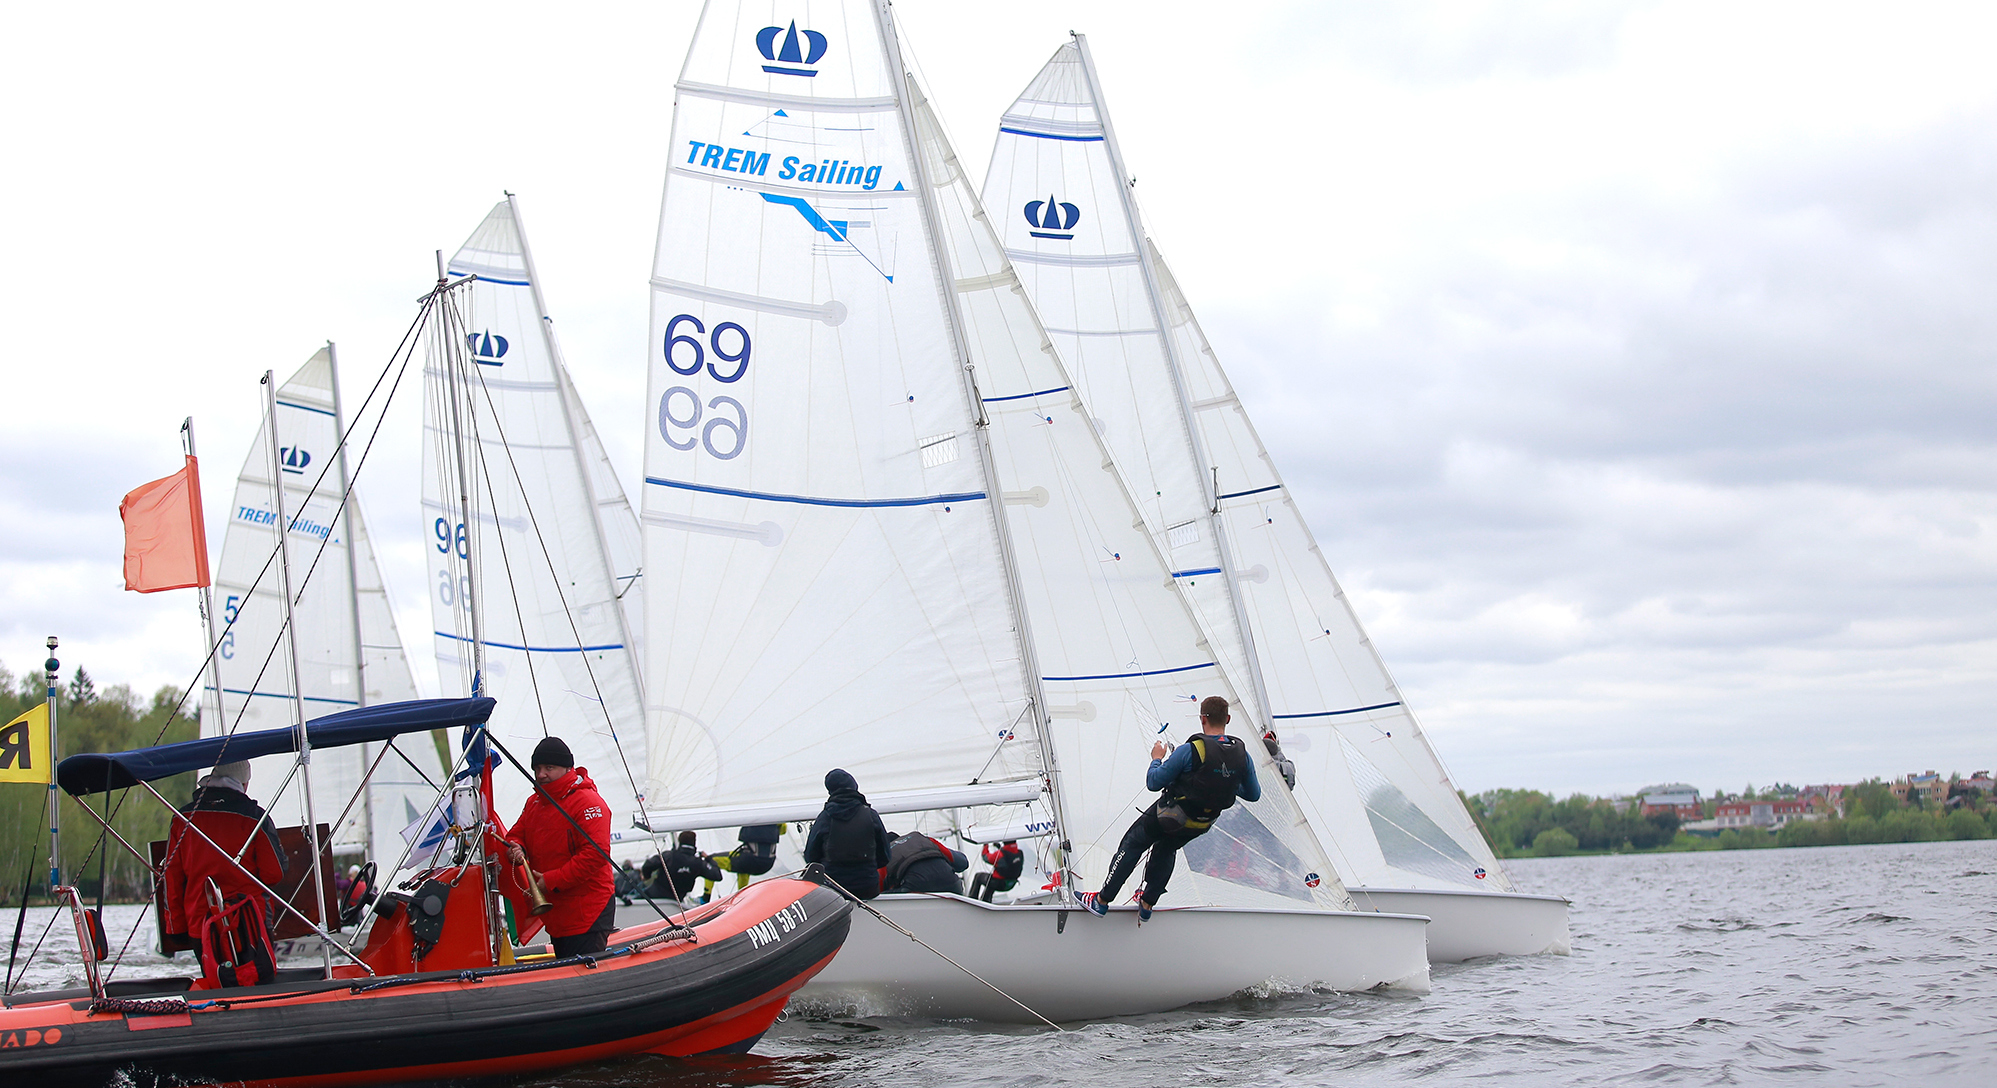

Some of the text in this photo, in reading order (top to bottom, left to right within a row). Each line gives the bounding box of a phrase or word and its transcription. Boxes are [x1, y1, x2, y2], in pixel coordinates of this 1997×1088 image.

[687, 140, 883, 191] TREM Sailing
[663, 313, 752, 384] 69
[237, 506, 277, 526] TREM
[435, 517, 468, 560] 96
[775, 899, 808, 933] 58-17
[0, 1027, 62, 1049] ADO
